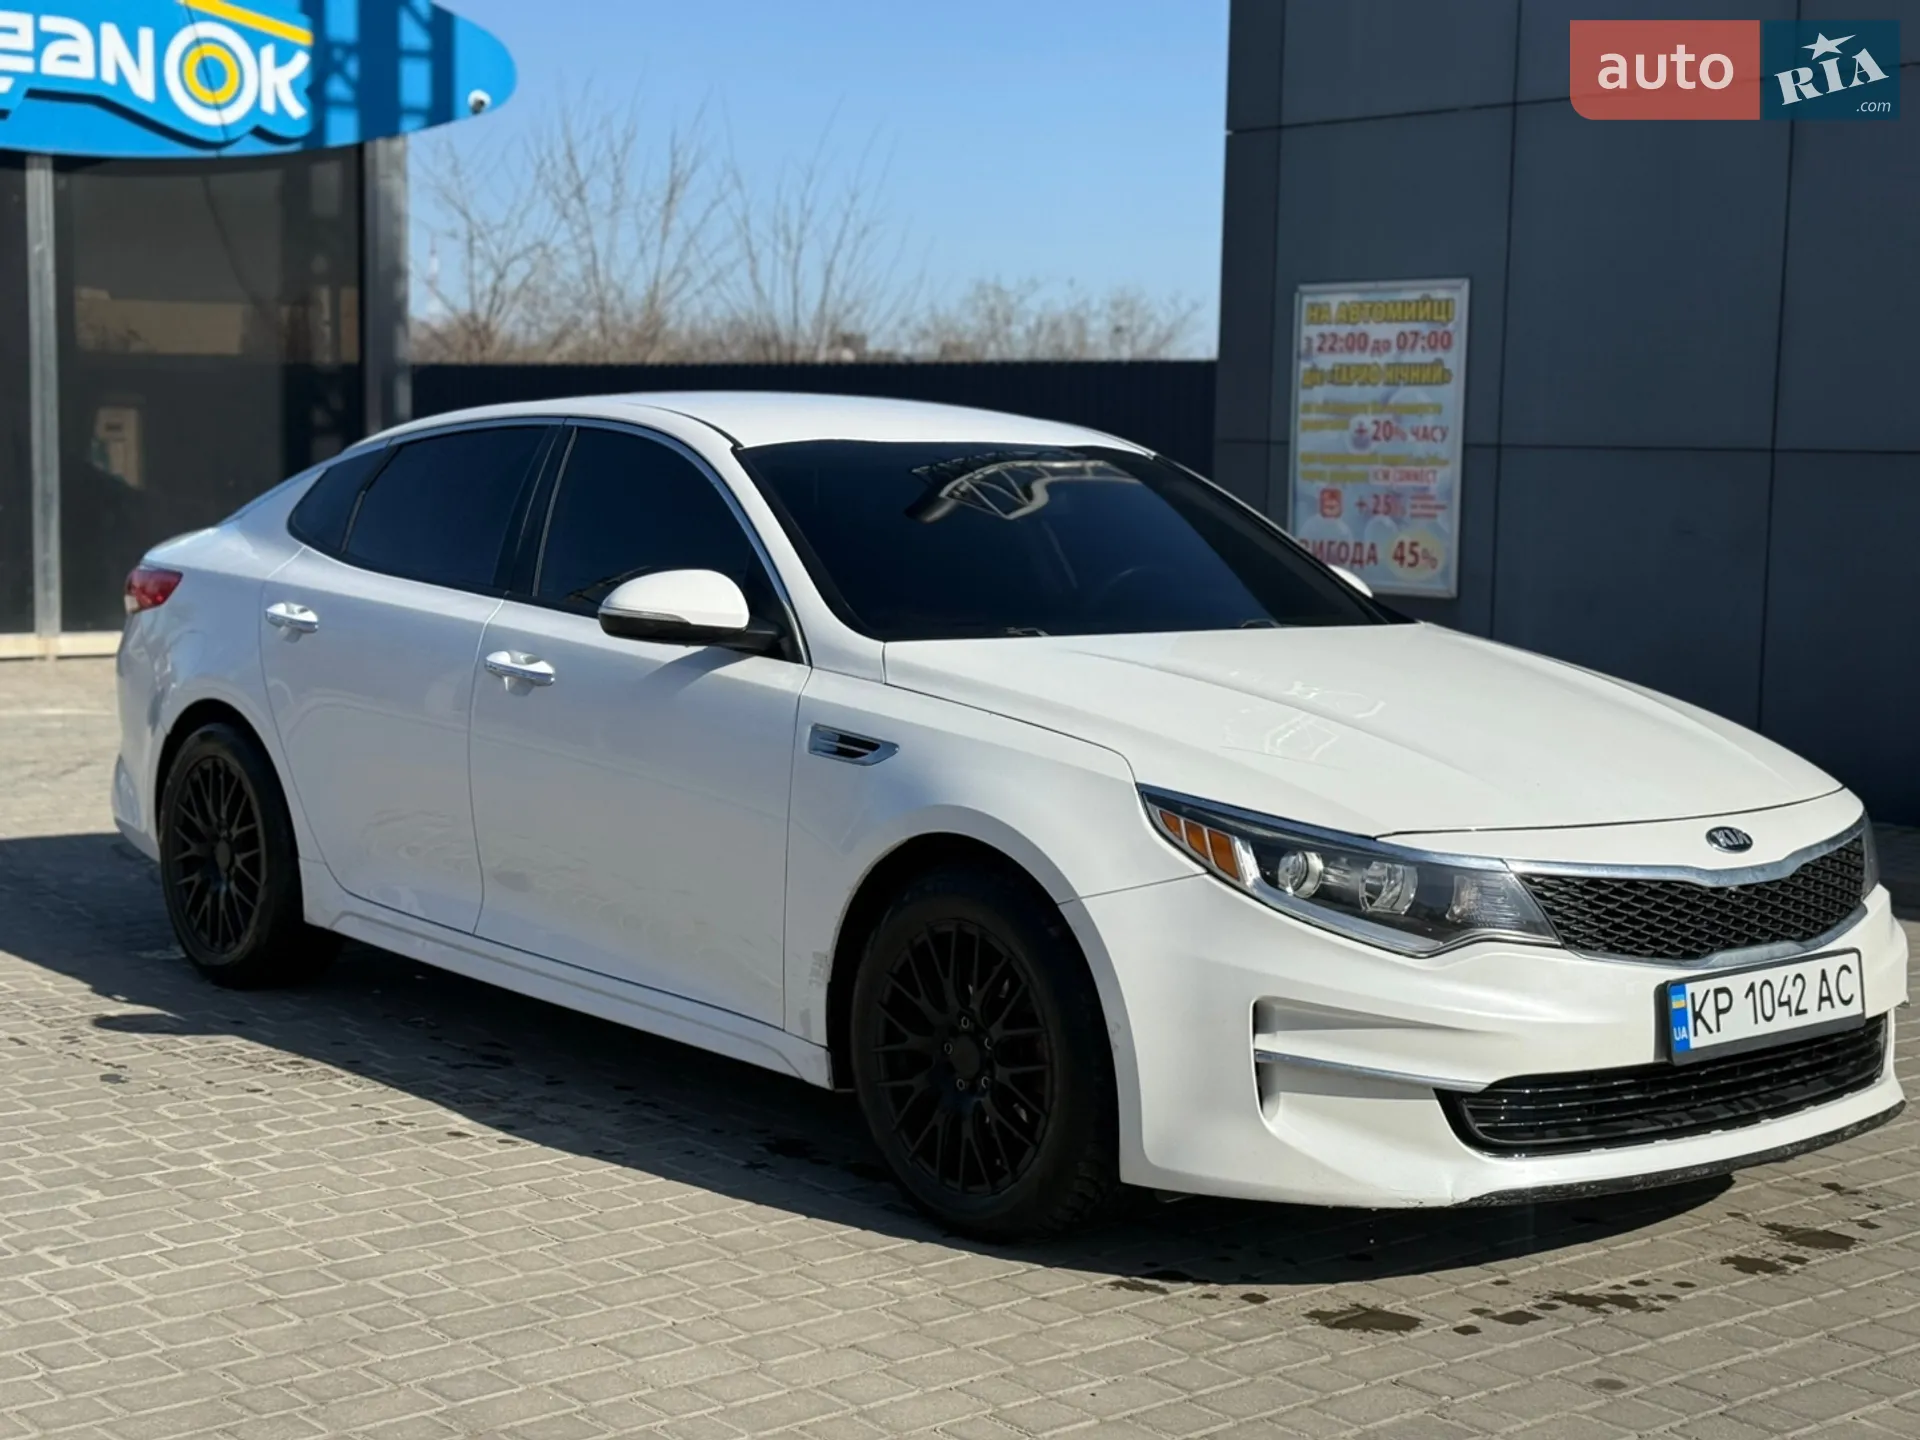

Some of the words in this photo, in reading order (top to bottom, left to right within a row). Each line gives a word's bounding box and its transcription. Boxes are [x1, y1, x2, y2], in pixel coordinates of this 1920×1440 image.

[1305, 302, 1332, 325] НА
[1335, 294, 1456, 326] АВТОМИЙЦІ
[1317, 332, 1369, 353] 22:00
[1370, 338, 1392, 355] до
[1396, 331, 1453, 351] 07:00
[1410, 426, 1449, 443] ЧАСУ
[1392, 541, 1438, 569] 45%
[1711, 829, 1751, 847] KIA
[1690, 986, 1734, 1037] KP
[1744, 973, 1808, 1025] 1042
[1817, 964, 1855, 1012] AC
[1674, 1027, 1688, 1041] UA
